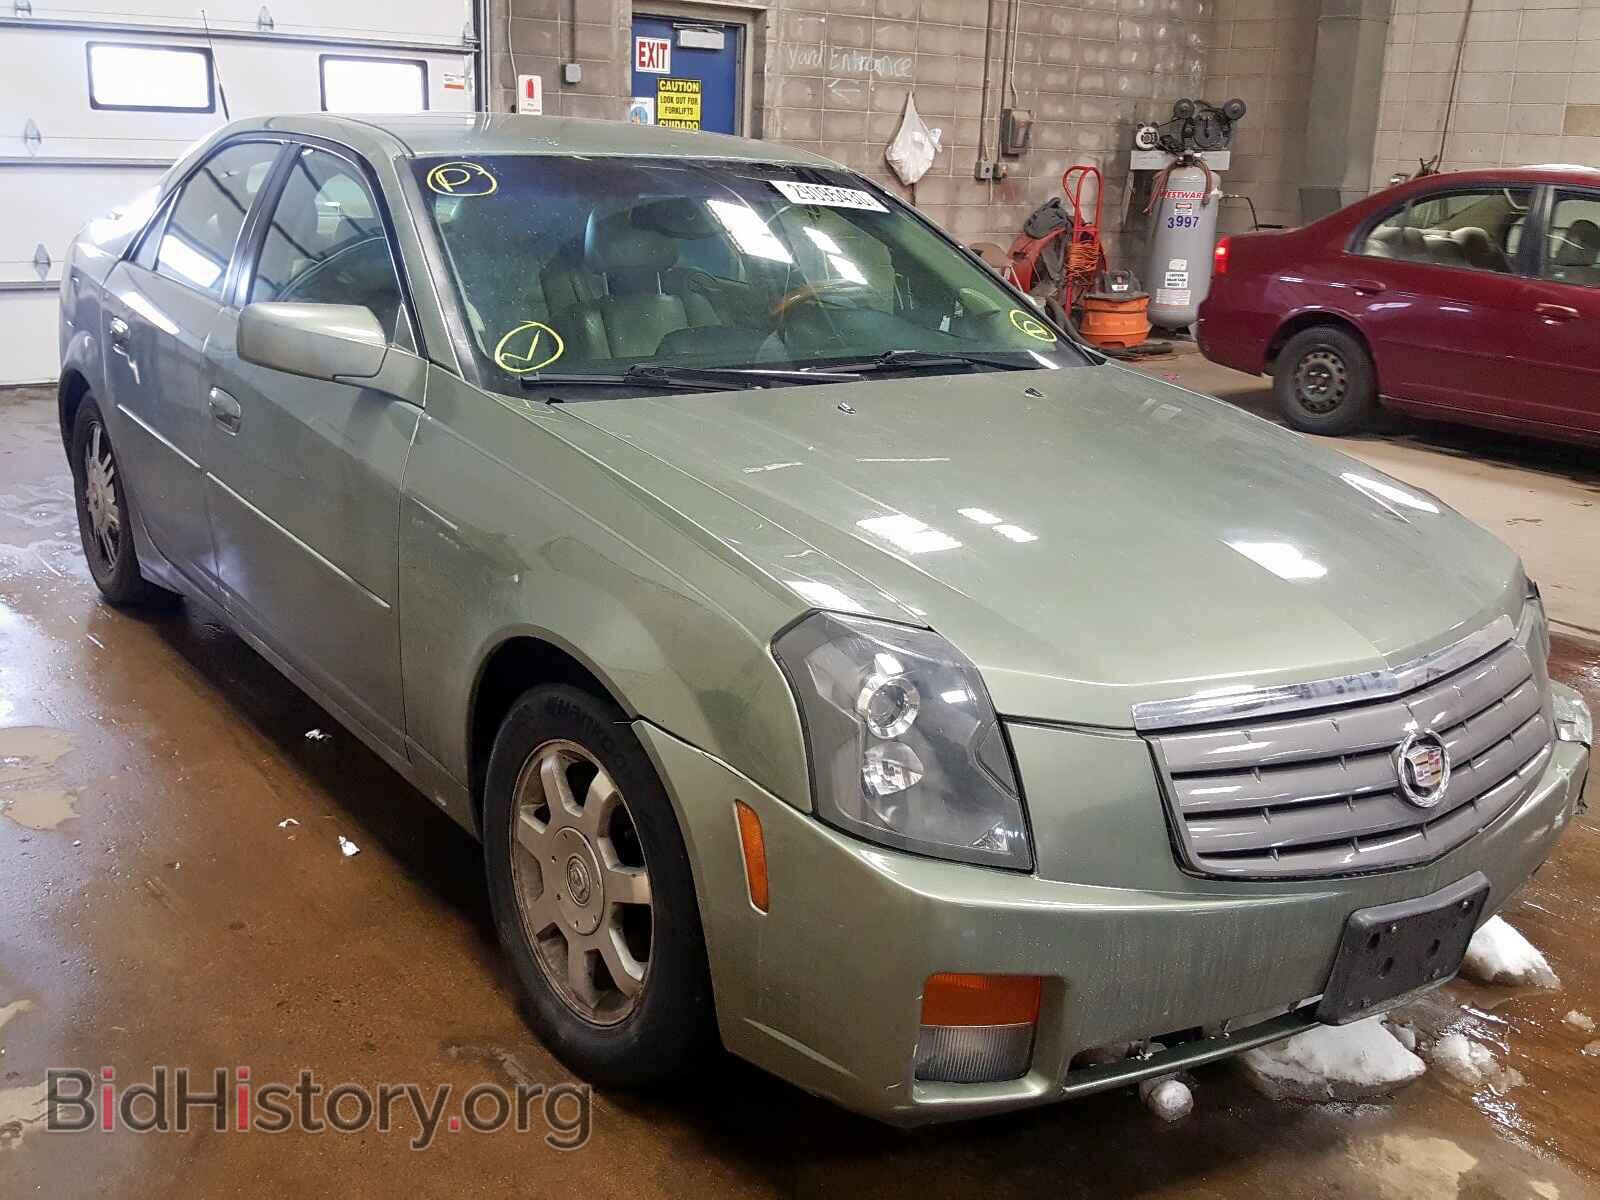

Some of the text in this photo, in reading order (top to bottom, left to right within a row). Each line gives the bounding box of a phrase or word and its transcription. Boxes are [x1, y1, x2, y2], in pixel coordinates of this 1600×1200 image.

[638, 41, 668, 69] EXIT
[659, 80, 700, 92] CAUTION
[660, 95, 699, 105] LOOK OUT FOR
[664, 106, 694, 115] FORKLIFTS
[659, 120, 699, 130] CUIDADO
[1167, 215, 1199, 229] 3997
